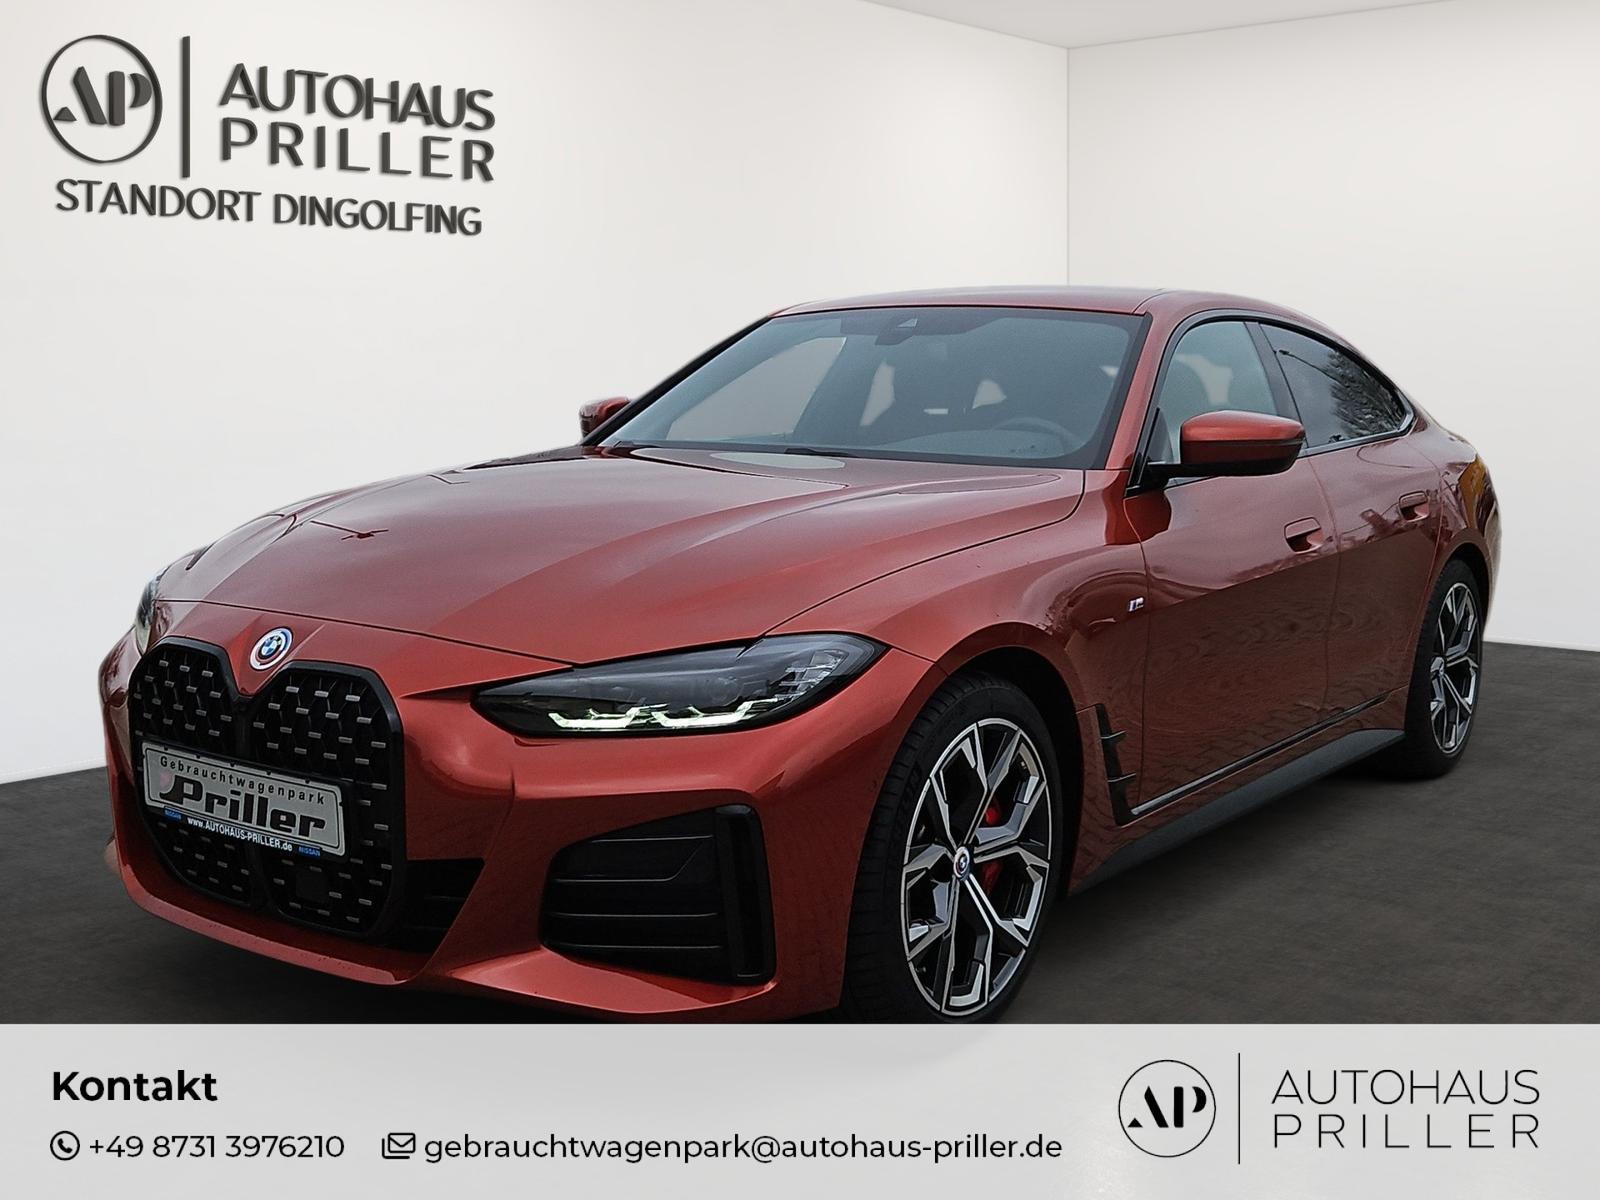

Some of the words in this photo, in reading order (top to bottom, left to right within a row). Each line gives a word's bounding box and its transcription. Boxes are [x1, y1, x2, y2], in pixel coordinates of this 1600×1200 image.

[219, 63, 496, 131] AUTOHAUS
[221, 117, 495, 182] PRILLER
[56, 178, 261, 222] STANDORT
[274, 193, 482, 236] DINGOLFING
[159, 775, 326, 837] Priller
[160, 756, 325, 805] Gebrauchtwagenpark
[187, 817, 293, 852] www.AUTOHAUS-PRILLER.de
